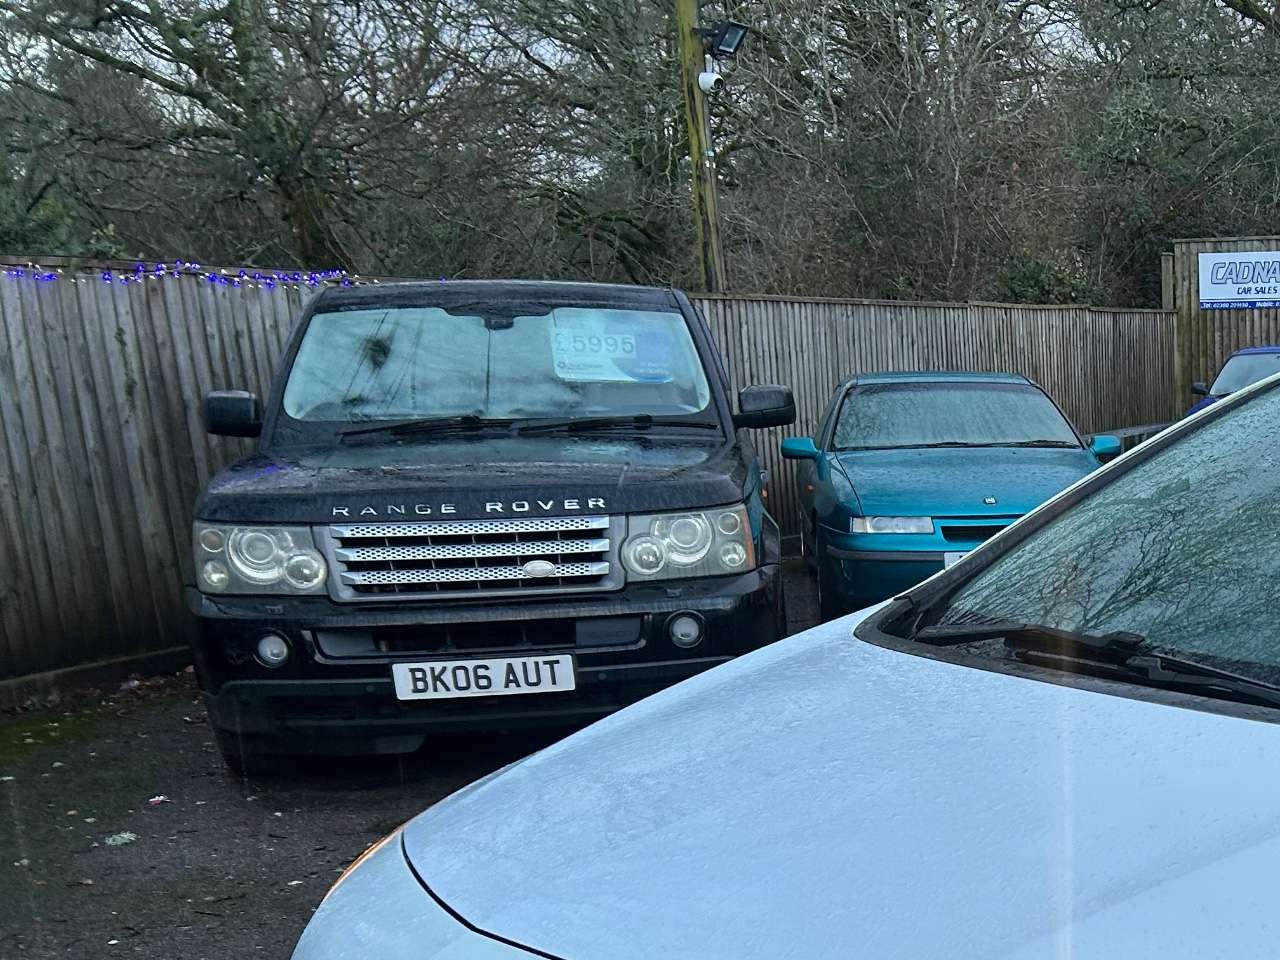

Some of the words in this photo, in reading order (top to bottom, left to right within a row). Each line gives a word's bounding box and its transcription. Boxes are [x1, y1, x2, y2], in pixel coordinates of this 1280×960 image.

[1237, 286, 1252, 295] CAR
[1254, 286, 1278, 295] SALES
[332, 503, 456, 516] RANGE
[485, 498, 606, 513] ROVER
[408, 664, 492, 693] BK06
[504, 660, 560, 688] AUT
